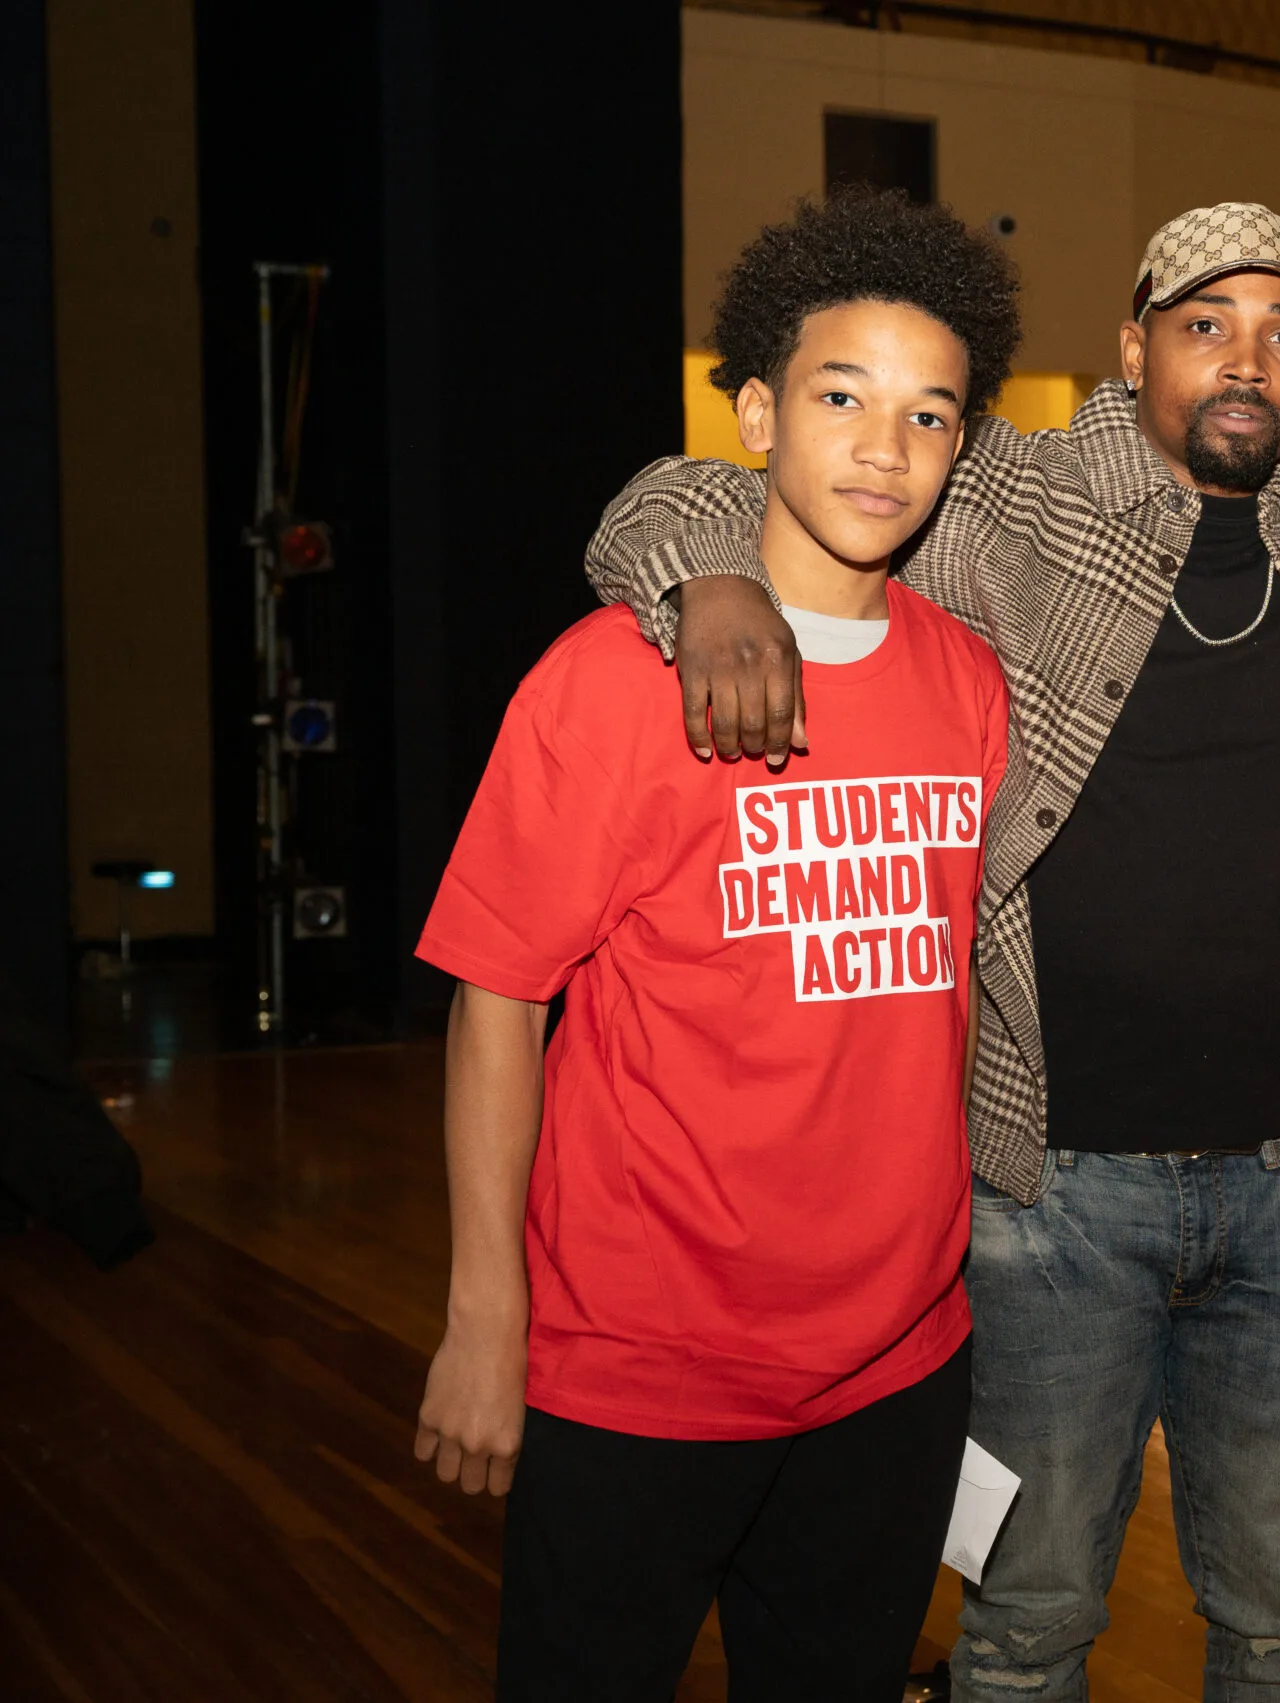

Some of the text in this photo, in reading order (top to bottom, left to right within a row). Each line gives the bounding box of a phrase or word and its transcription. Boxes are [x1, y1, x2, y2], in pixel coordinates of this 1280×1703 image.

[744, 782, 977, 854] STUDENTS
[723, 854, 922, 931] DEMAND
[802, 924, 953, 995] ACTION
